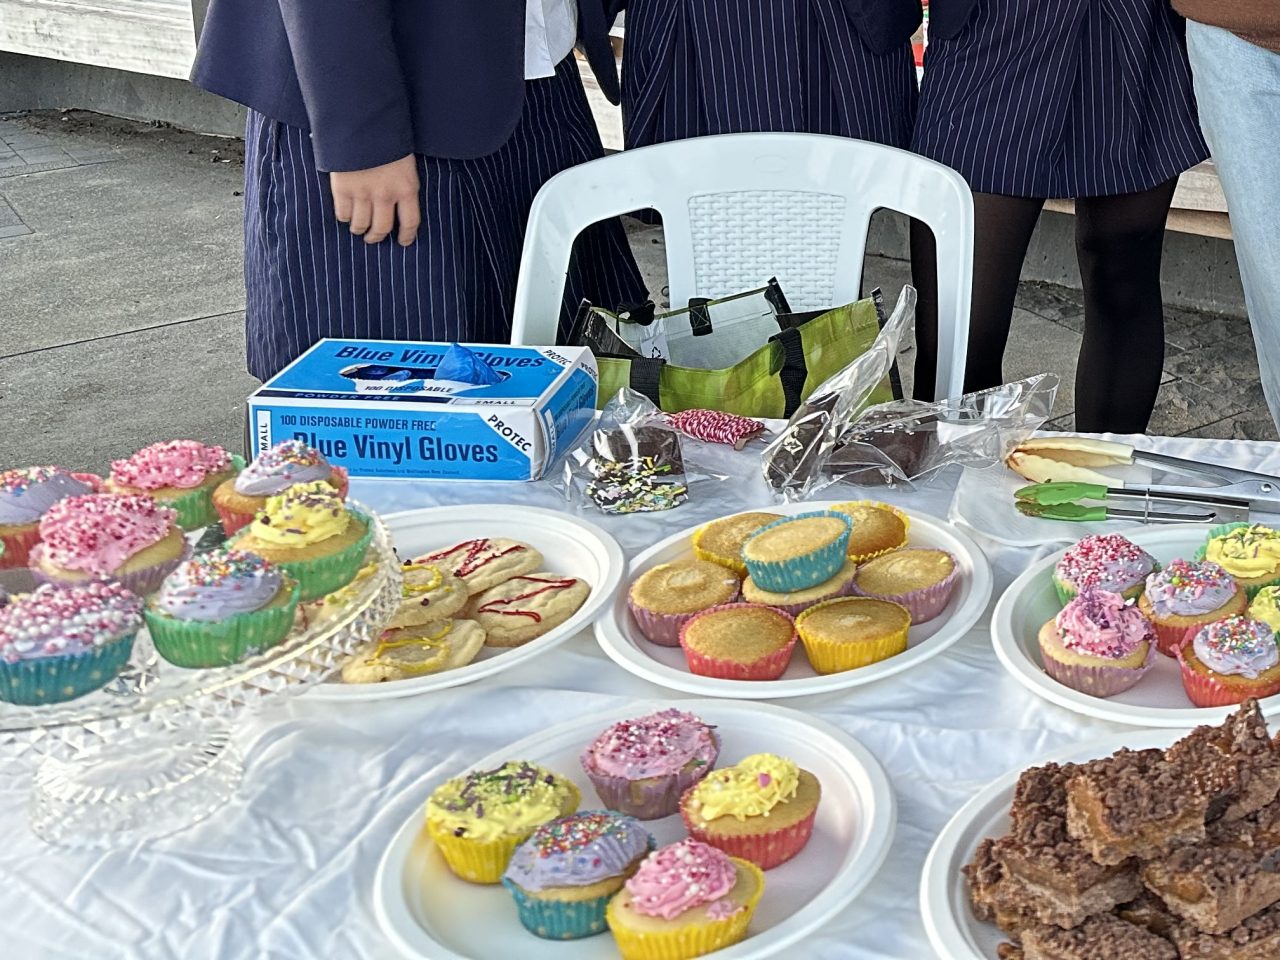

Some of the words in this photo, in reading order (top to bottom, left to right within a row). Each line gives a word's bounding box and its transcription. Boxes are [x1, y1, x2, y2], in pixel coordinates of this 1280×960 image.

[335, 346, 394, 362] Blue
[400, 349, 443, 368] Viny
[543, 349, 573, 366] PROTEC
[294, 392, 360, 400] POWDER
[384, 385, 454, 394] DISPOSABLE
[280, 414, 297, 426] 100
[300, 415, 362, 429] DISPOSABLE
[365, 418, 408, 431] POWDER
[411, 419, 437, 432] FREE
[487, 414, 533, 452] PROTEC
[260, 422, 269, 451] MALL
[353, 433, 412, 465] Vinyl
[418, 435, 499, 464] Gloves
